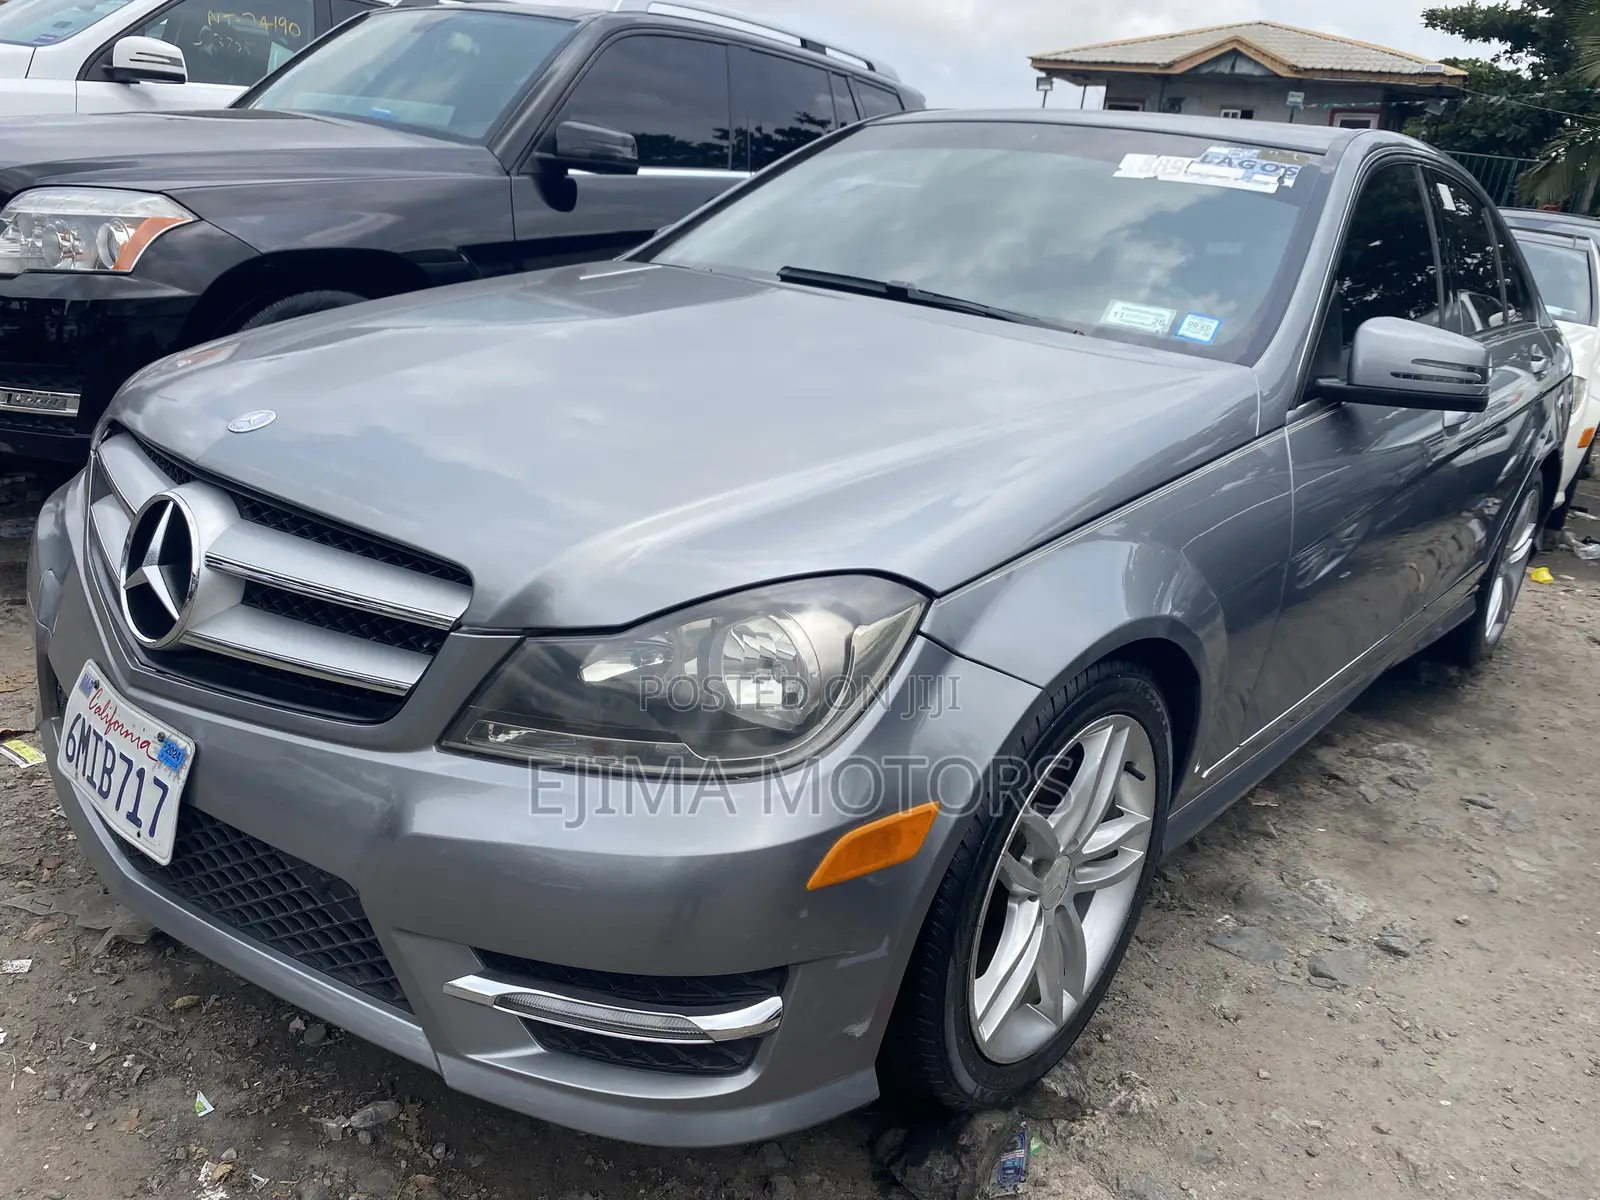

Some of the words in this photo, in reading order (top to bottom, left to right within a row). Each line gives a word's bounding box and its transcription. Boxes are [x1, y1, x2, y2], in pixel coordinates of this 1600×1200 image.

[1200, 153, 1300, 177] LAGOS
[89, 688, 158, 763] California
[65, 712, 170, 838] 6MIB717
